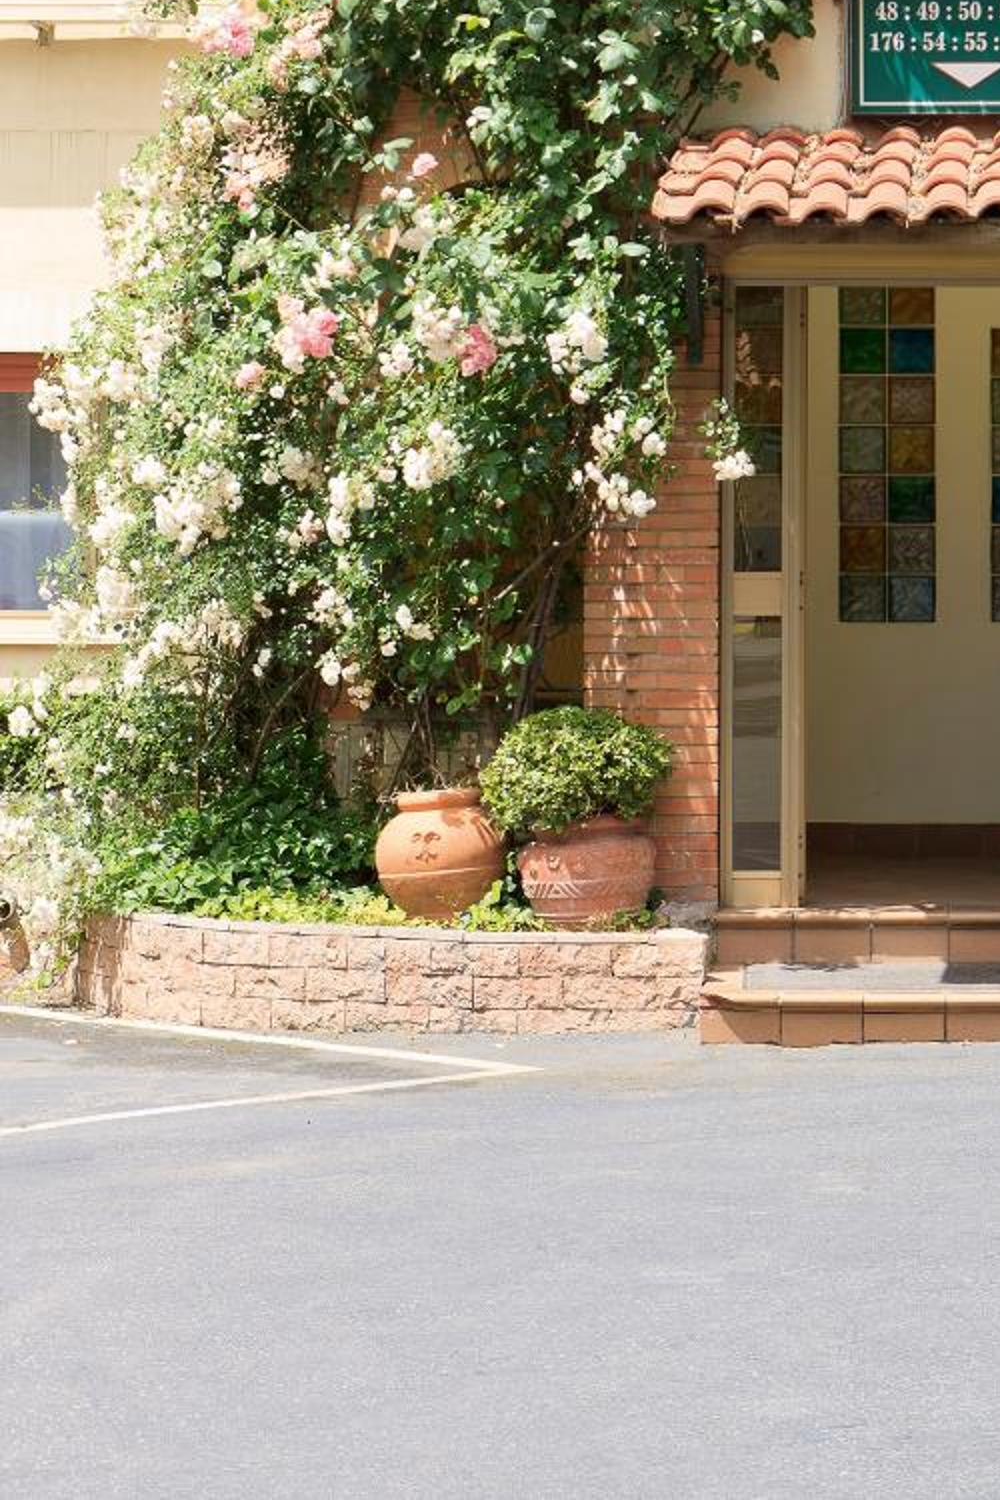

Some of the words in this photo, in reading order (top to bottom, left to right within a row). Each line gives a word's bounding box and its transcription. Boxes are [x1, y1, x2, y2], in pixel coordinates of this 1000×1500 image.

[875, 1, 899, 21] 48
[916, 1, 940, 21] 49
[958, 1, 982, 21] 50
[869, 31, 905, 52] 176
[922, 31, 946, 52] 54
[963, 31, 988, 52] 55
